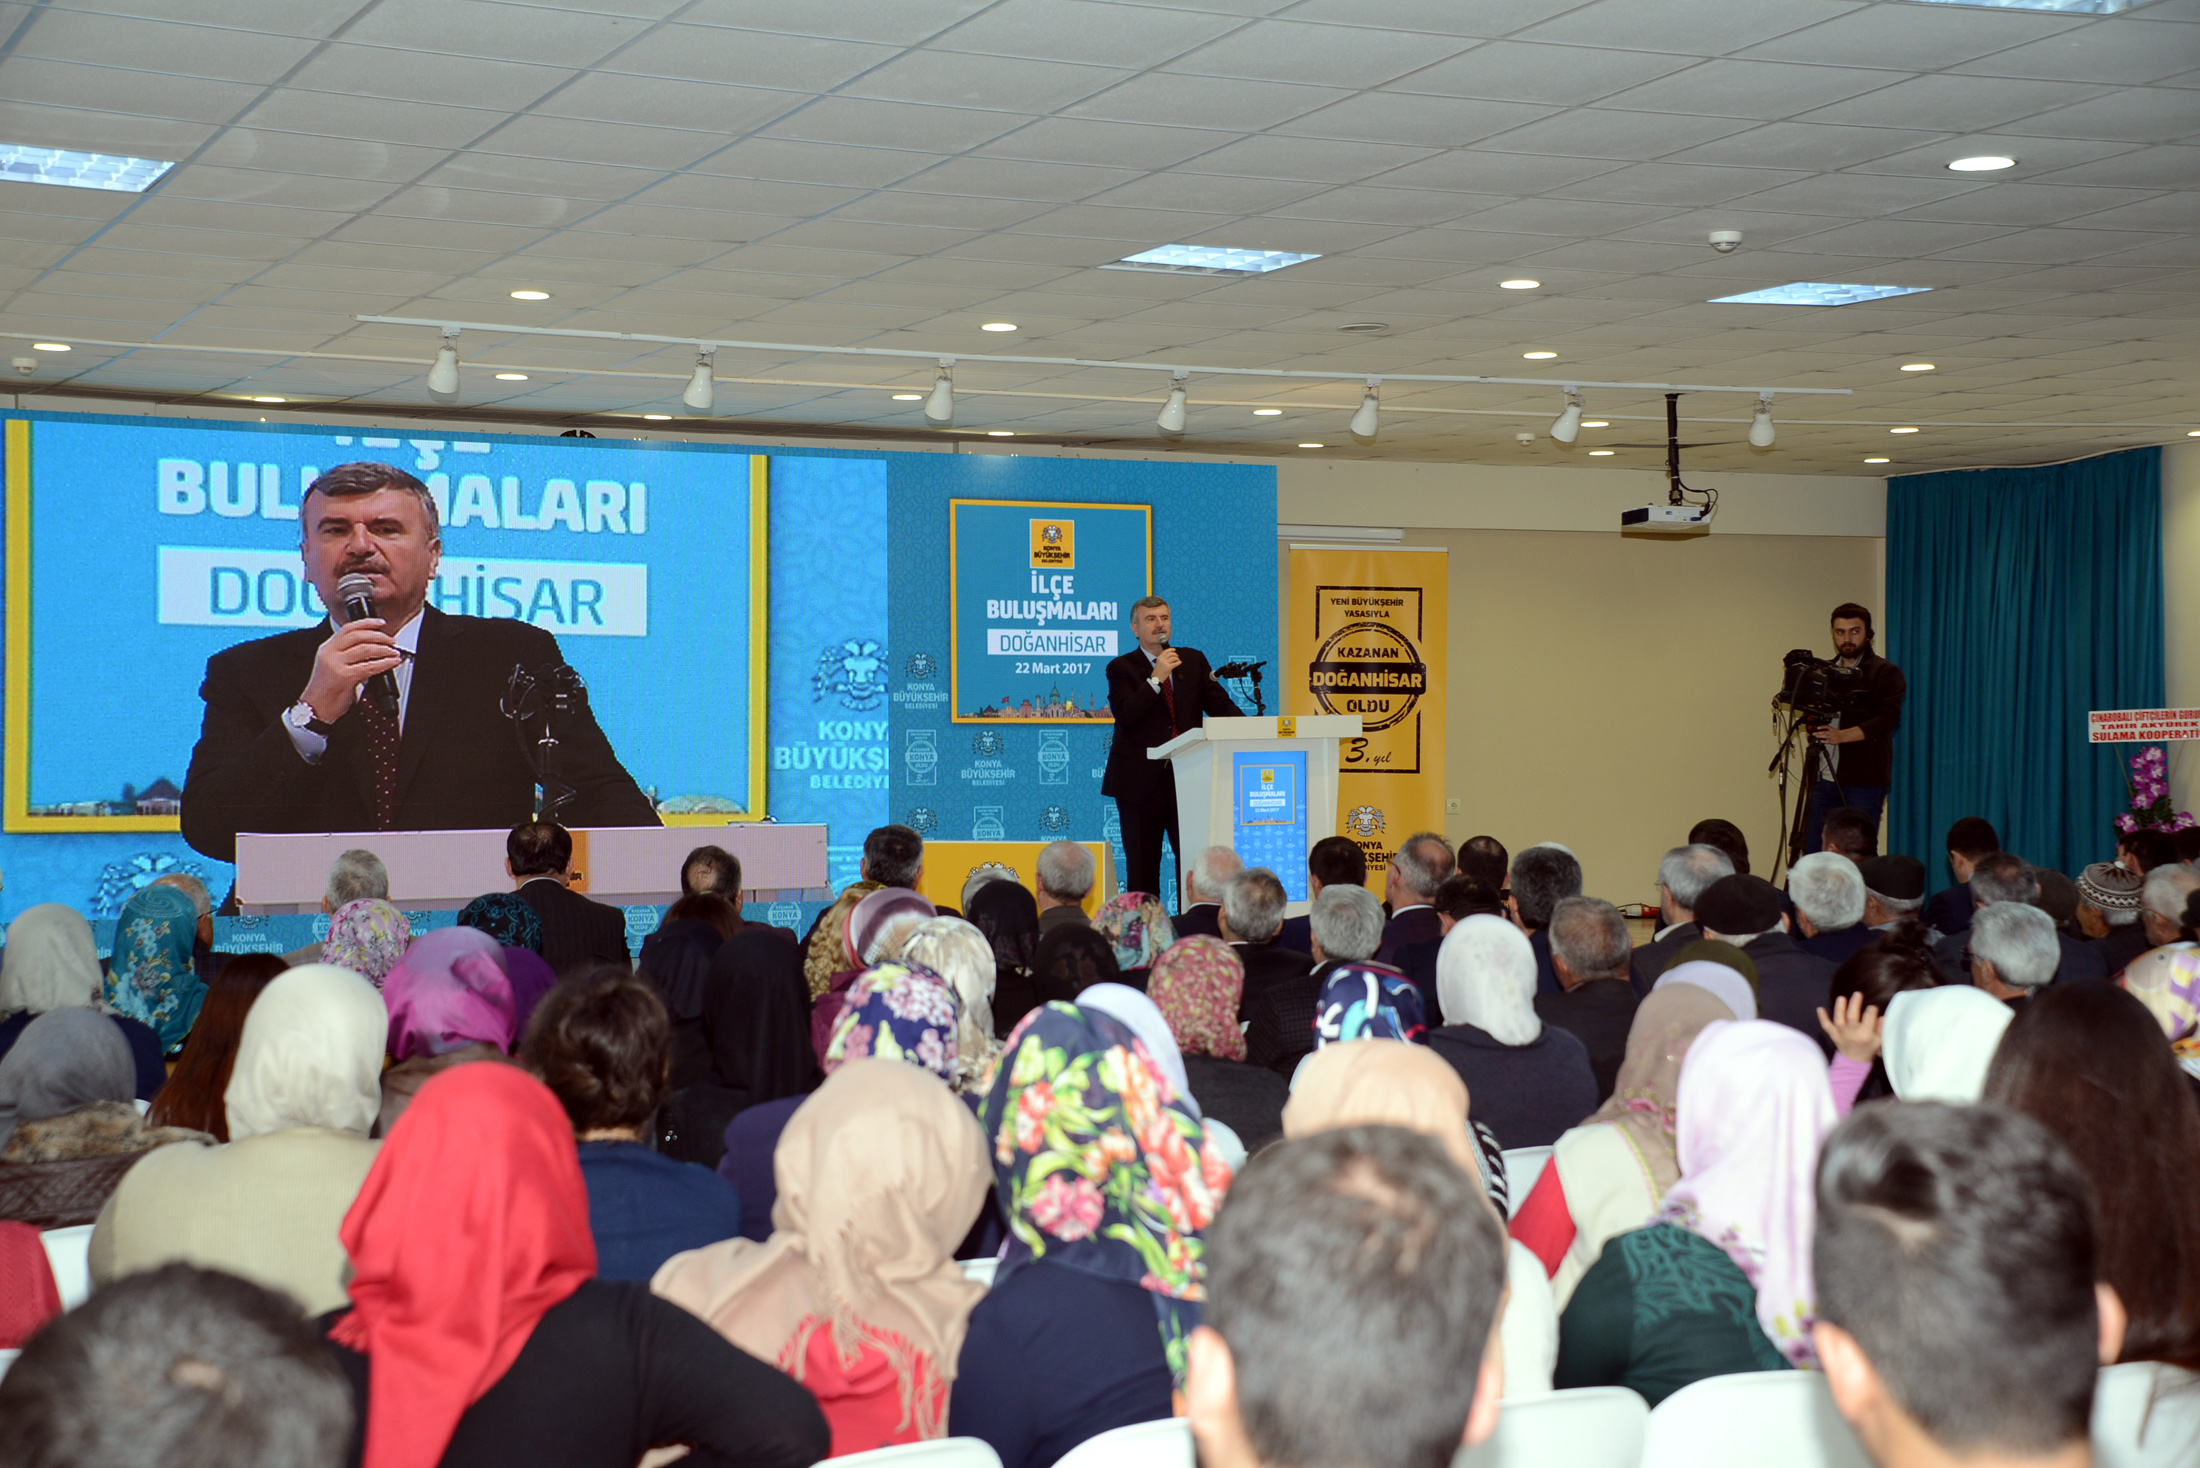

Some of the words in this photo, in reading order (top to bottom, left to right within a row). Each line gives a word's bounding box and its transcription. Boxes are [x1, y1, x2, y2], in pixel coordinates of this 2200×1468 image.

[158, 458, 647, 535] BULALARI
[1031, 570, 1074, 600] İLÇE
[210, 564, 605, 626] DOHİSAR
[1331, 597, 1350, 605] YENİ
[1352, 597, 1404, 607] BÜYÜKŞEHİR
[987, 600, 1117, 626] BULUŞMALARI
[1344, 610, 1390, 618] YASASIYLA
[1000, 631, 1106, 652] DOĞANHİSAR
[1337, 647, 1399, 658] KAZANAN
[1015, 662, 1029, 674] 22
[1032, 663, 1060, 674] Mart
[1062, 663, 1091, 674] 2017
[1313, 669, 1422, 687] DOĞANHİSAR
[907, 683, 935, 691] KONYA
[893, 691, 948, 702] BÜYÜKŞEHİR
[1346, 699, 1390, 713] OLDU
[819, 720, 889, 741] KONY
[2092, 731, 2136, 741] SULAMA
[974, 760, 1002, 768] KONYA
[961, 769, 1016, 779] BÜYÜKŞEHİR
[629, 914, 655, 922] KONYA
[772, 911, 798, 919] KONYA
[232, 934, 266, 942] KONYA
